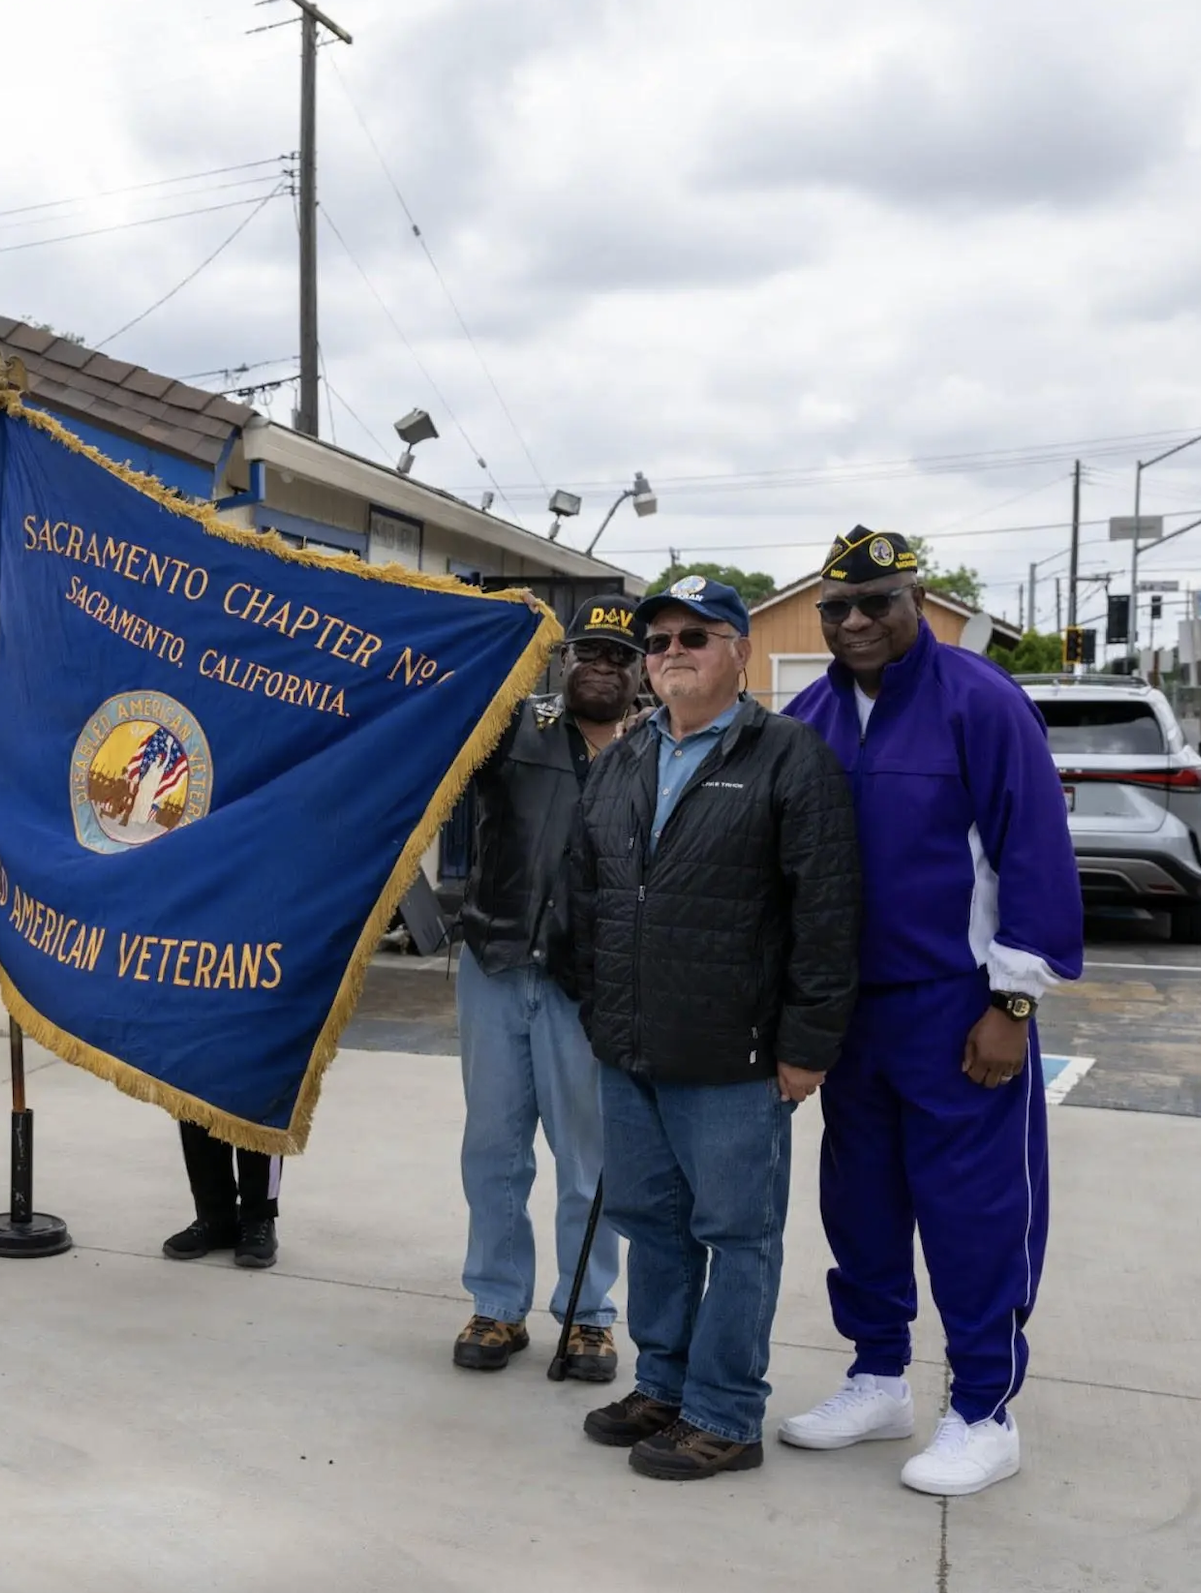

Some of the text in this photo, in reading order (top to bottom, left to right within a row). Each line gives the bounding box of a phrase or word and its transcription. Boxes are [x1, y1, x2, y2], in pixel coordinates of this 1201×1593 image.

[23, 515, 209, 601] SACRAMENTO
[223, 582, 383, 669] CHAPTER
[75, 715, 113, 805] DISABLED
[117, 698, 192, 742] AMERICAN
[9, 884, 106, 972] AMERICAN
[118, 931, 283, 990] VETERANS
